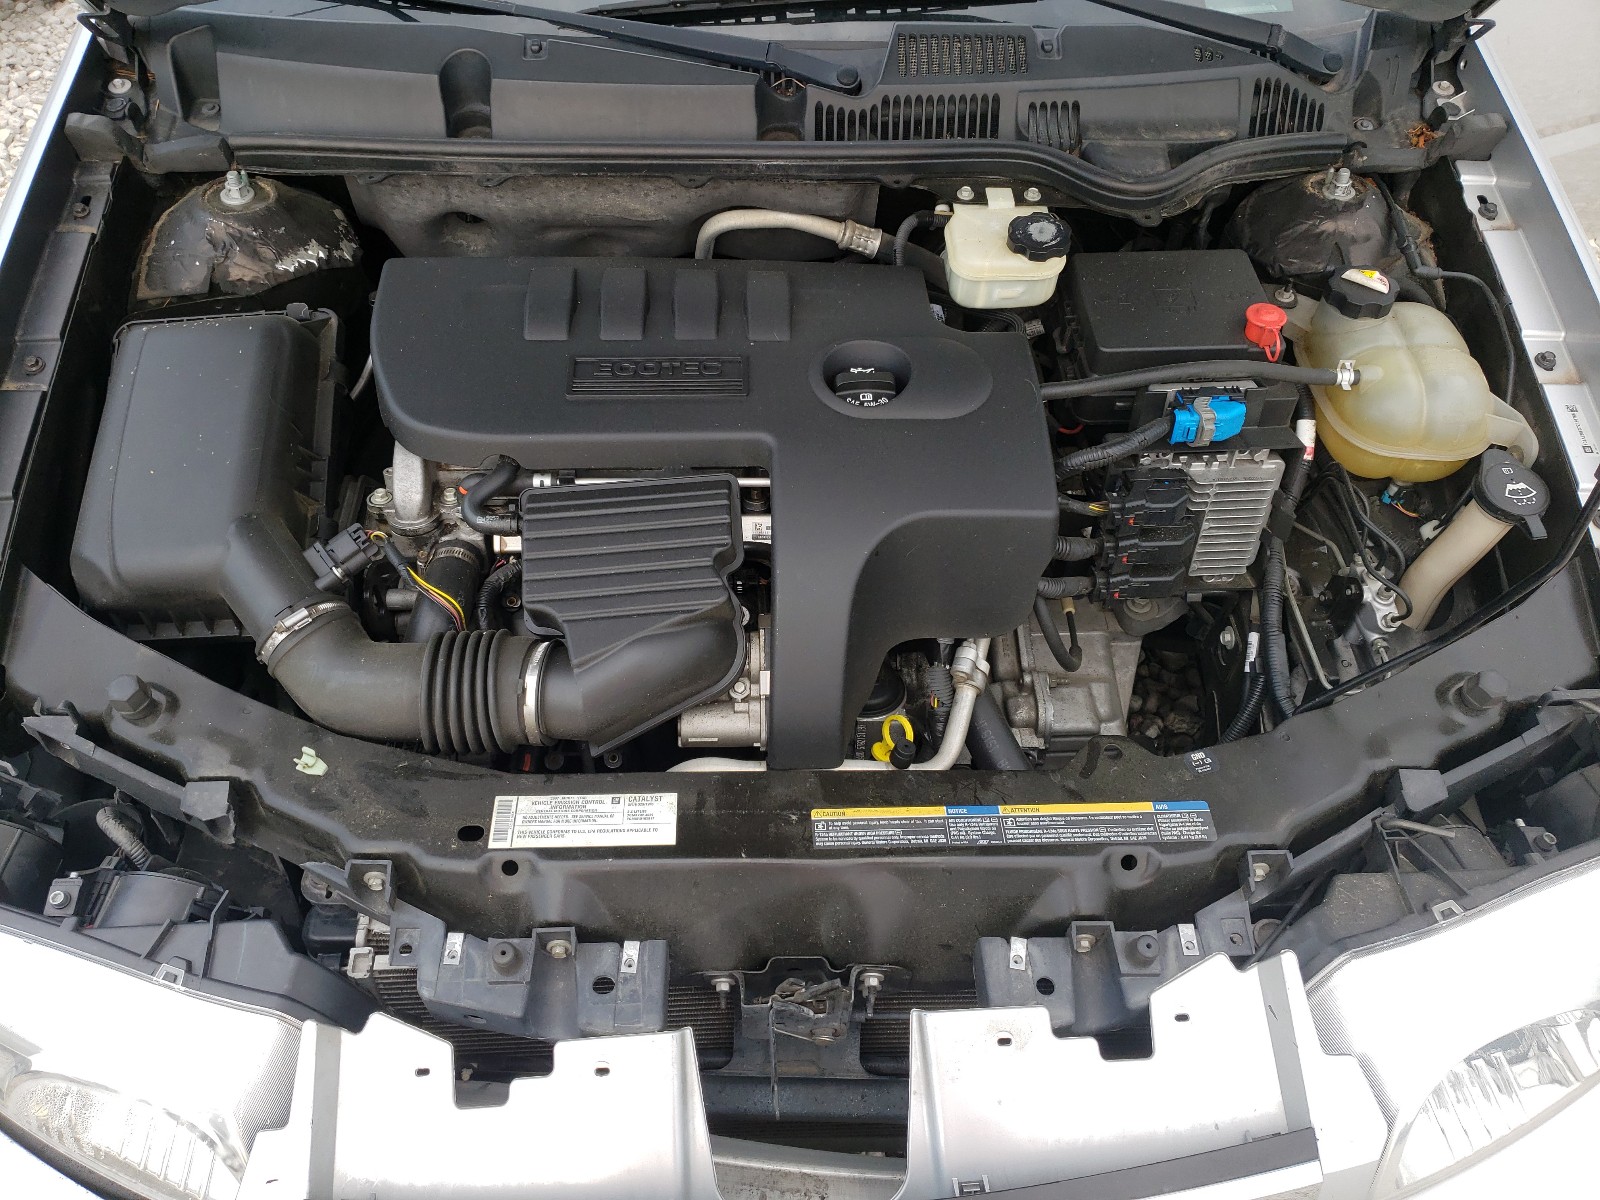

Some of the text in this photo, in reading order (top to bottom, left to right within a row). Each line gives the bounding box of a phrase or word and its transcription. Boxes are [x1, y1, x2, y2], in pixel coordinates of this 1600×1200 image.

[593, 361, 722, 376] ECOTEC
[1190, 751, 1206, 761] GND
[628, 795, 663, 803] CATALYST
